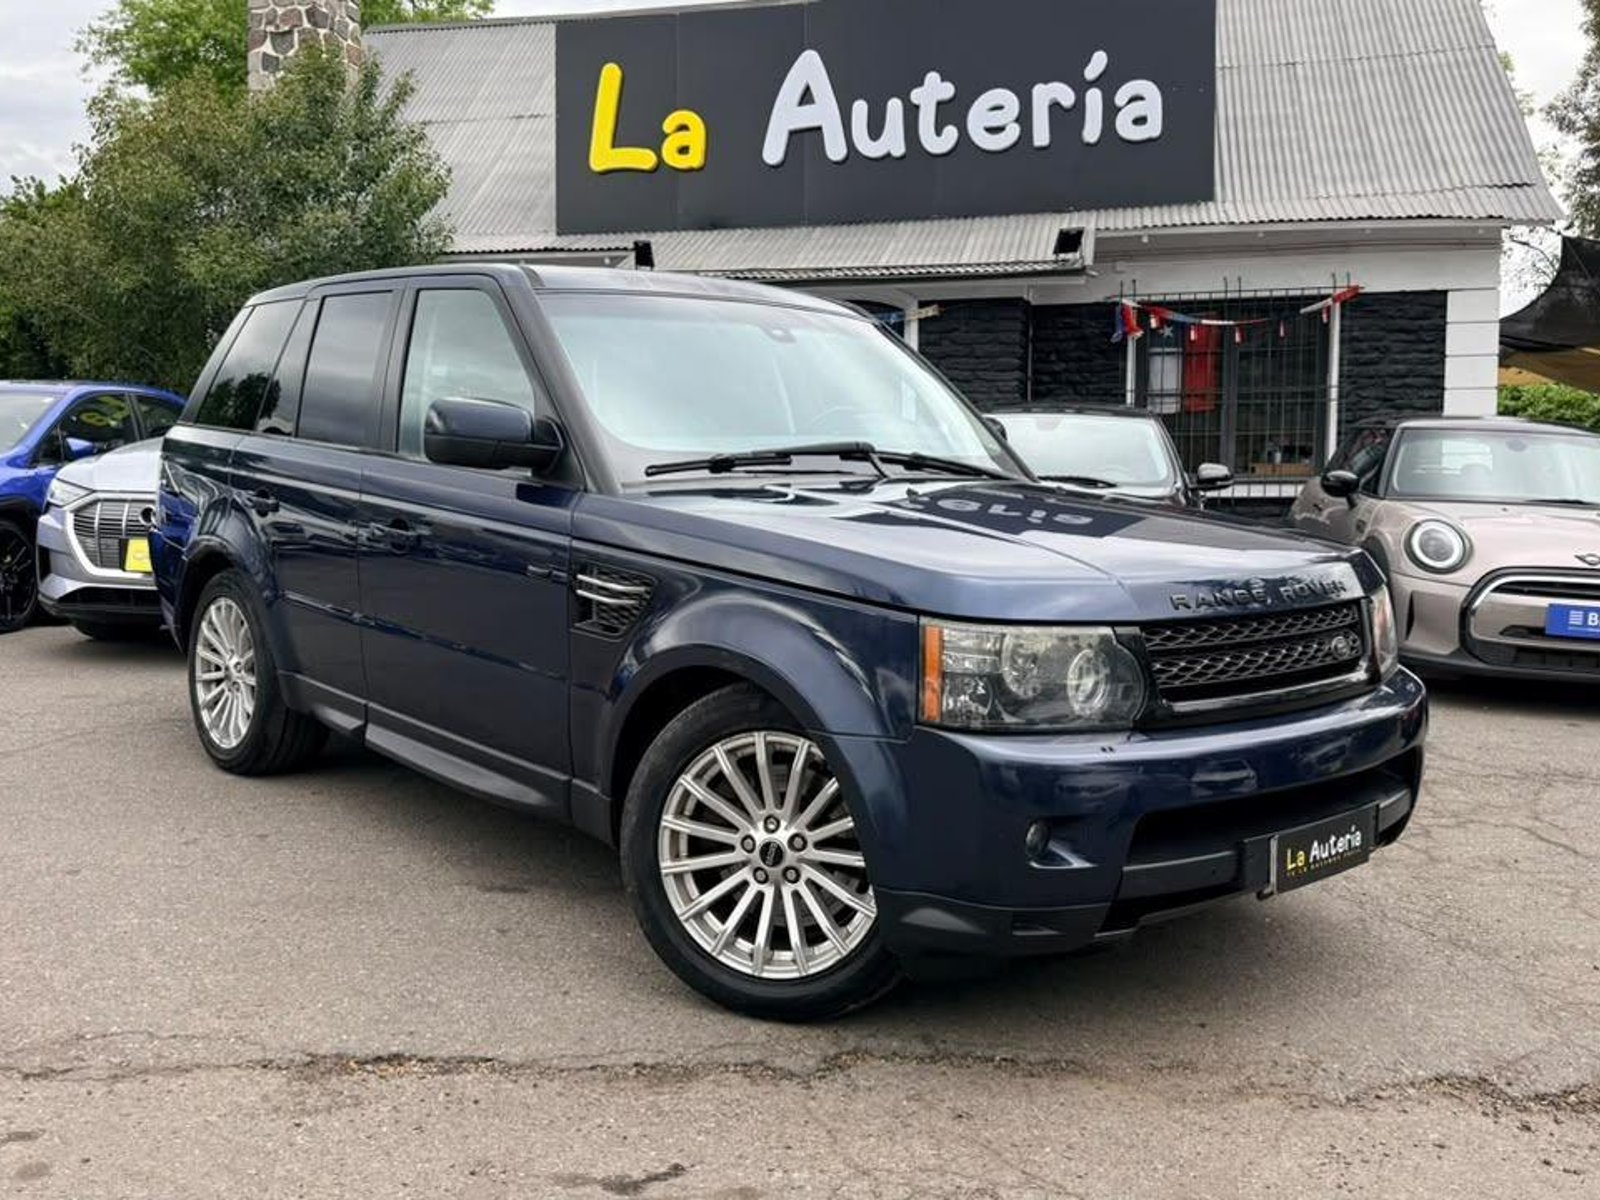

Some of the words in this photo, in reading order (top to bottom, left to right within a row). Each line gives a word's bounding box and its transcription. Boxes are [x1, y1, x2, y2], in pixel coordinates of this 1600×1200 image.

[588, 62, 707, 172] La
[762, 49, 1163, 165] Autería
[1170, 586, 1267, 611] RANGE
[1279, 579, 1348, 601] ROVER
[1286, 848, 1306, 870] La
